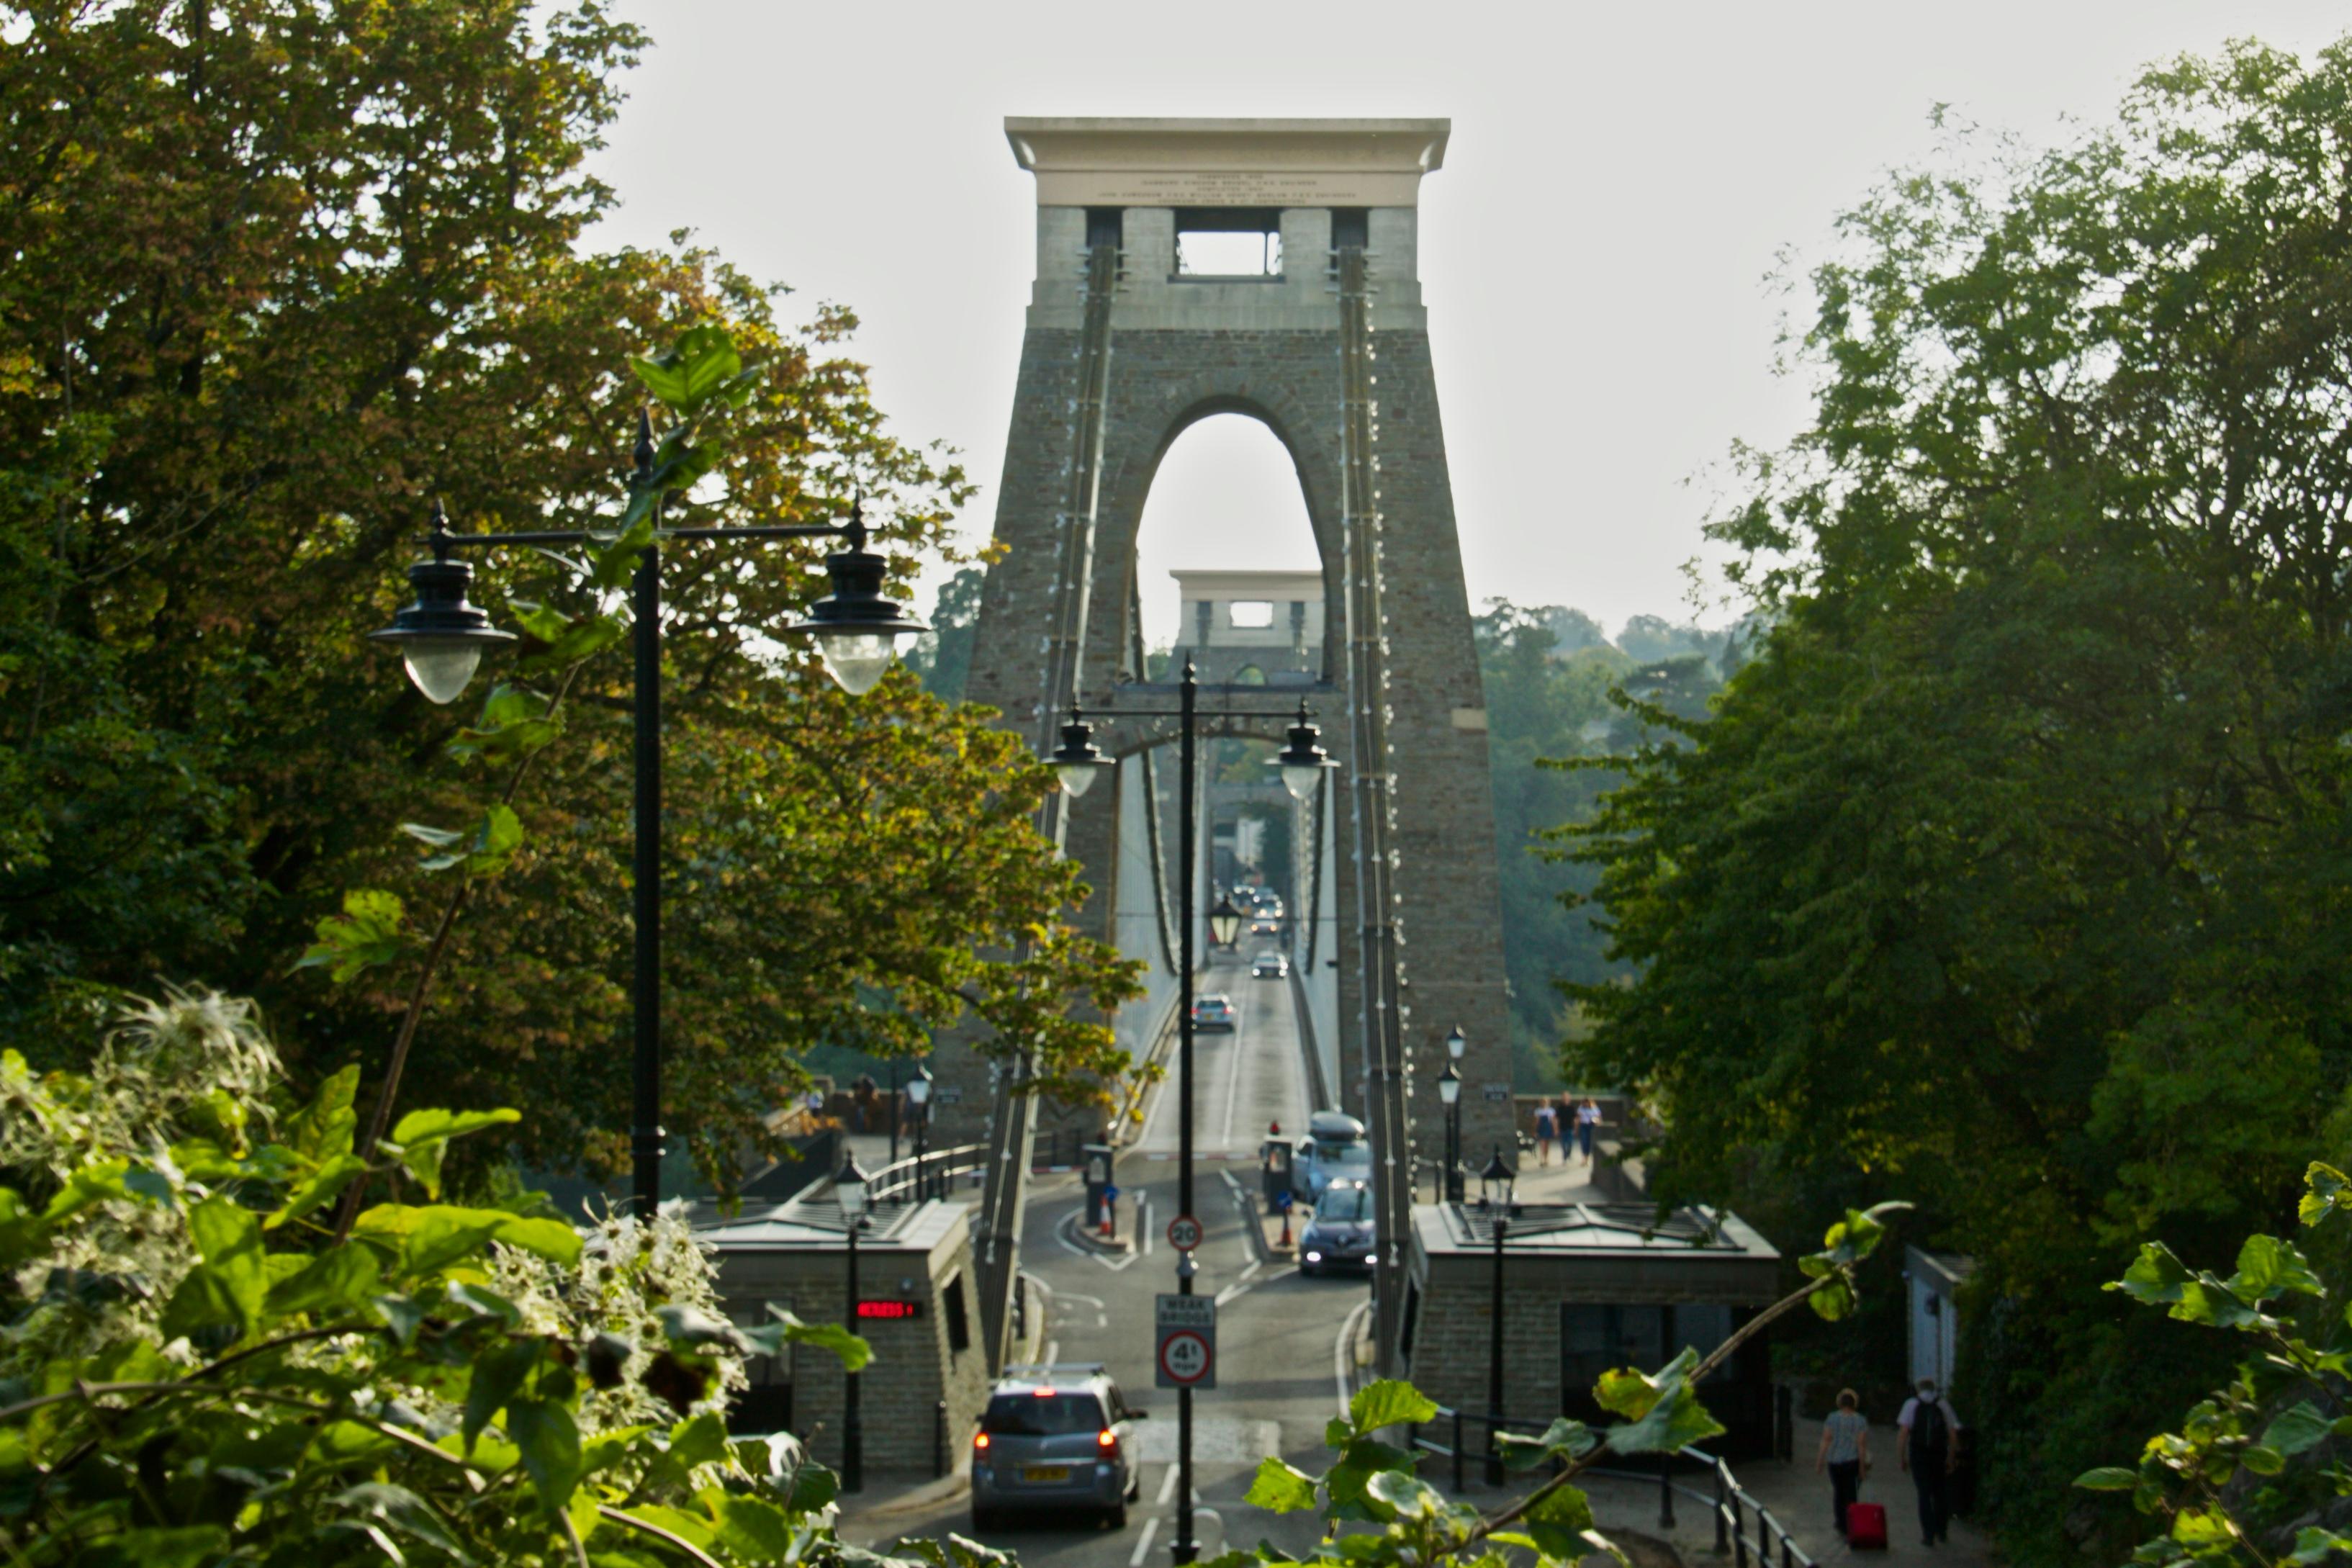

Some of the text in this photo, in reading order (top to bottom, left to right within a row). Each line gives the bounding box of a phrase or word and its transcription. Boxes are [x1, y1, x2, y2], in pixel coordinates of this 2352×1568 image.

[1173, 1225, 1197, 1242] 20
[1167, 1299, 1205, 1310] WEAK
[1160, 1311, 1210, 1323] BRIDGE
